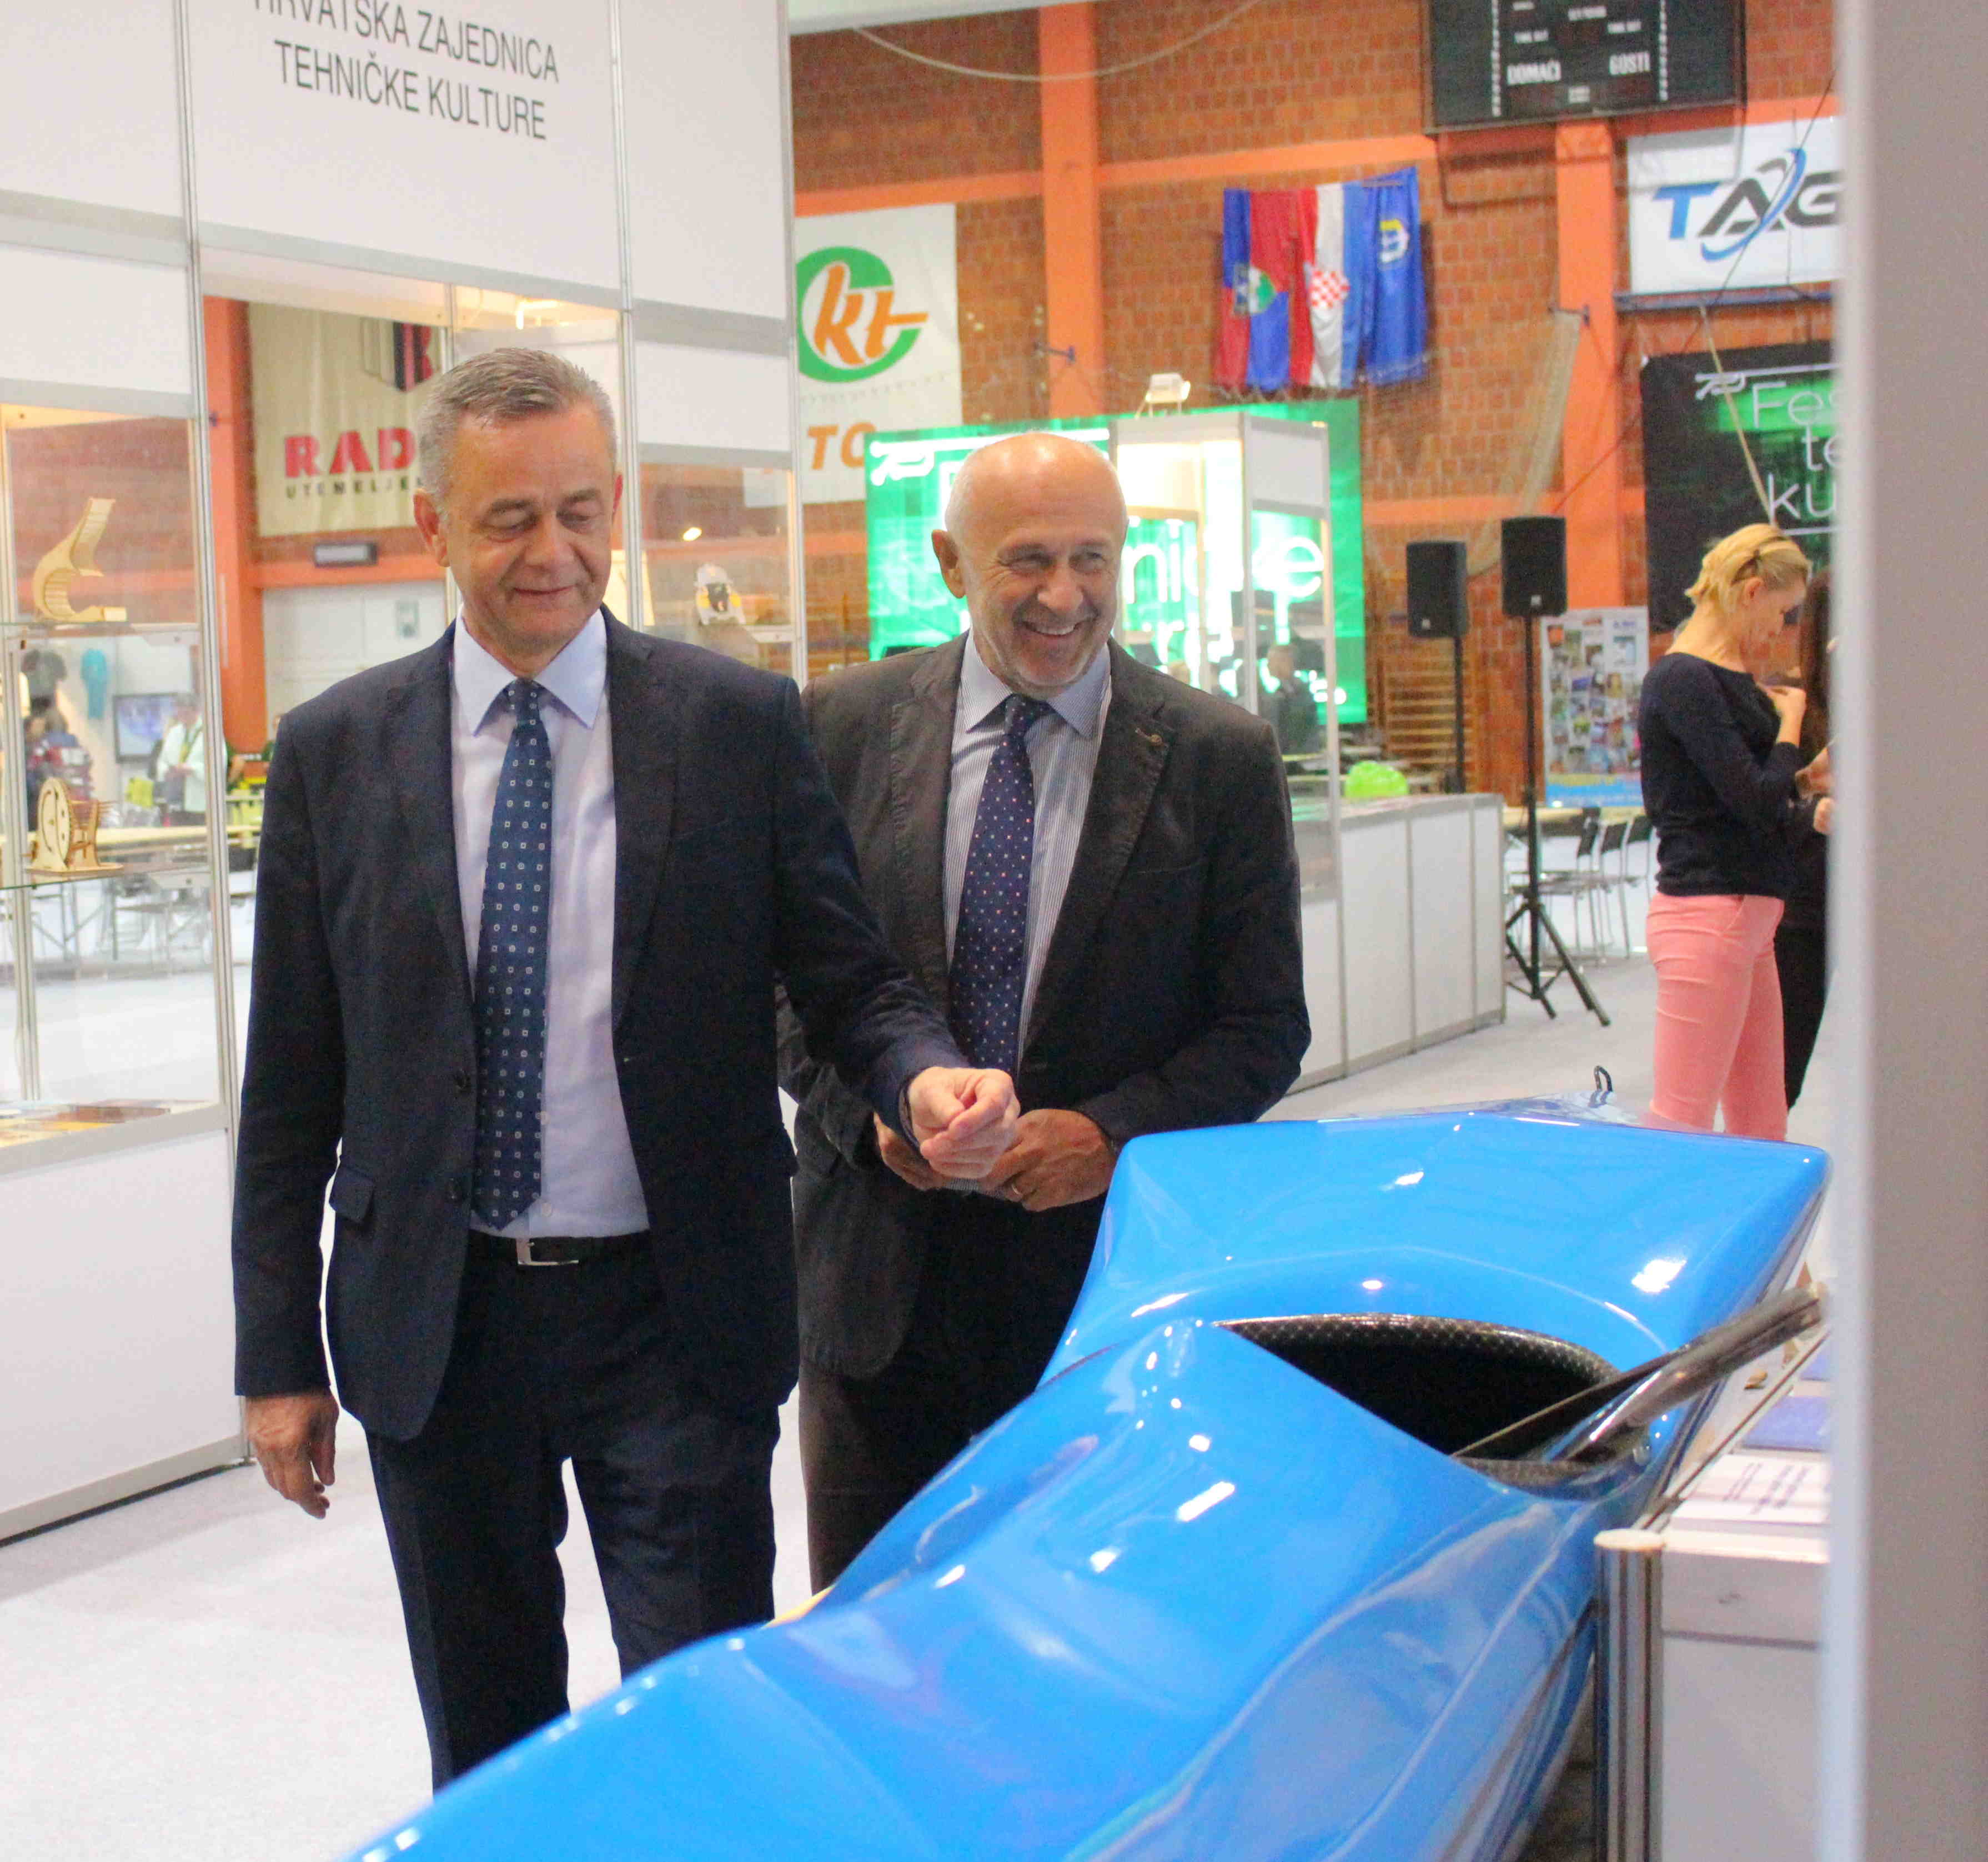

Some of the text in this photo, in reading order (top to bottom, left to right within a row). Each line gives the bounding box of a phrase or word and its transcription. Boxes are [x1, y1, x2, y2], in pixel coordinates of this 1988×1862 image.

[255, 0, 559, 83] VATSKA ZAJEDNICA
[1608, 51, 1651, 76] GOSTI
[274, 39, 546, 140] TEHNIČKE KULTURE
[284, 426, 416, 478] RAD
